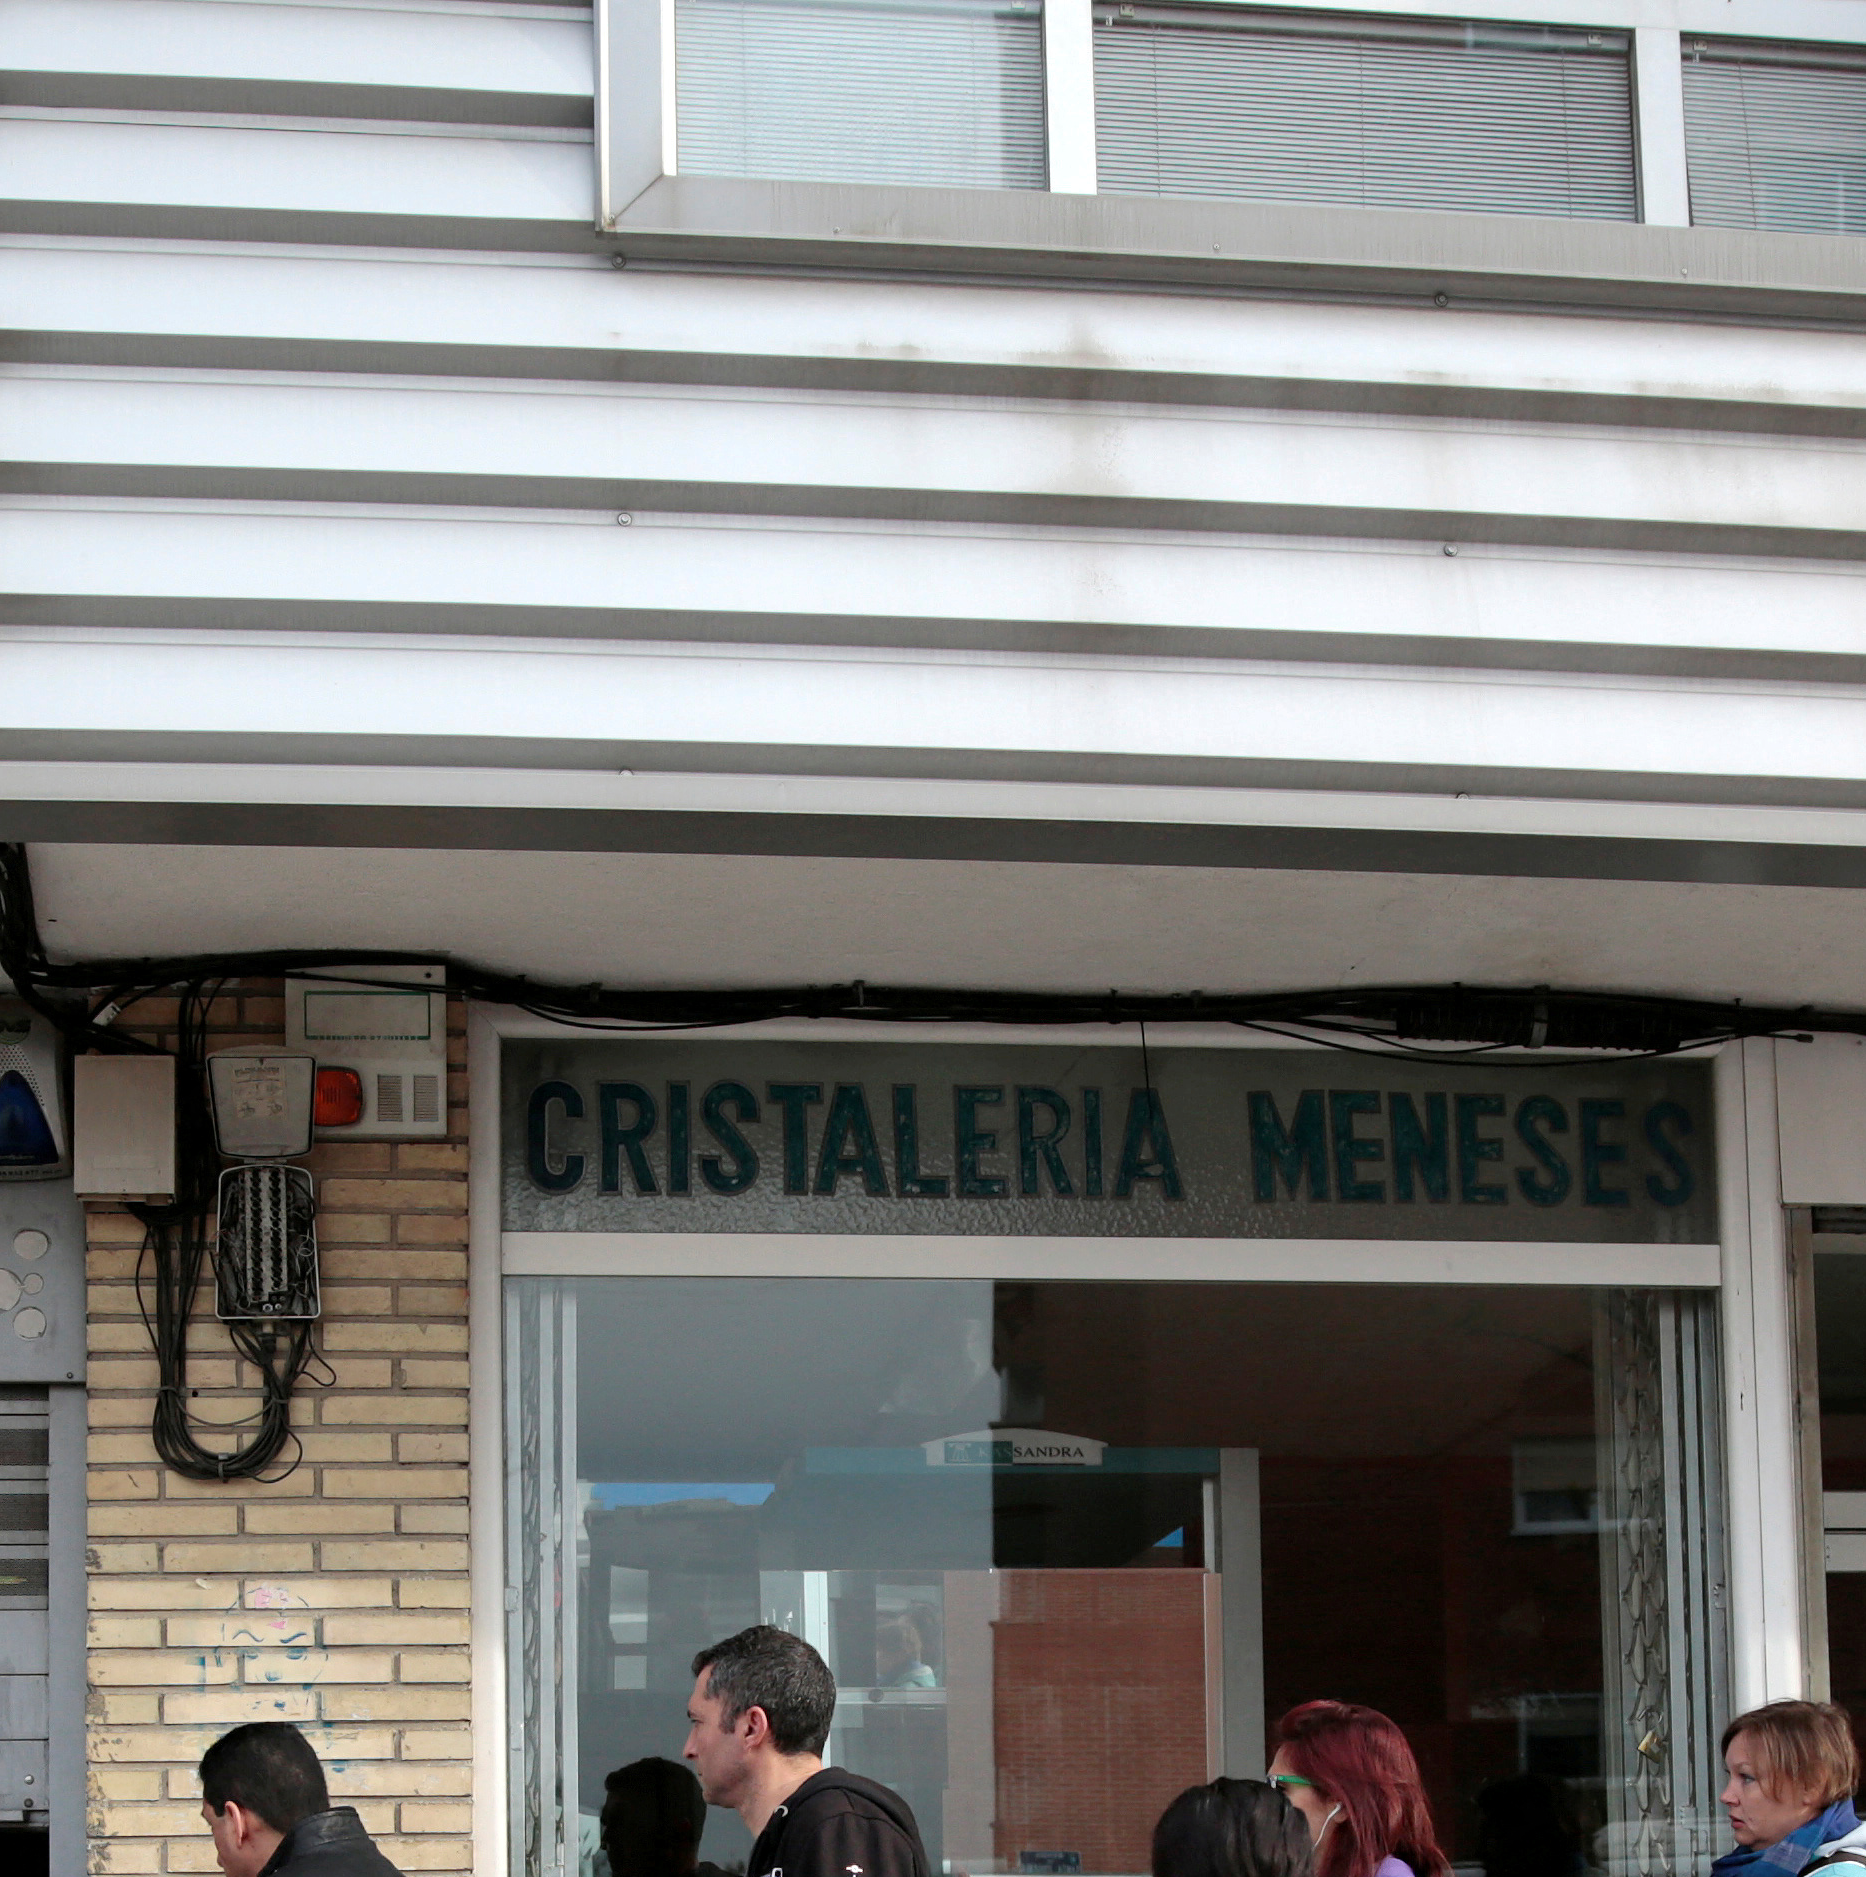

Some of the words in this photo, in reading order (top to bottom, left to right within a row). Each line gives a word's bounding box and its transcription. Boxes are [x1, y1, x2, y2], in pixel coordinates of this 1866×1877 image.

[525, 1078, 1186, 1202] CRISTALERIA
[1245, 1088, 1698, 1208] MENESES
[977, 1445, 1085, 1459] KASSANDRA
